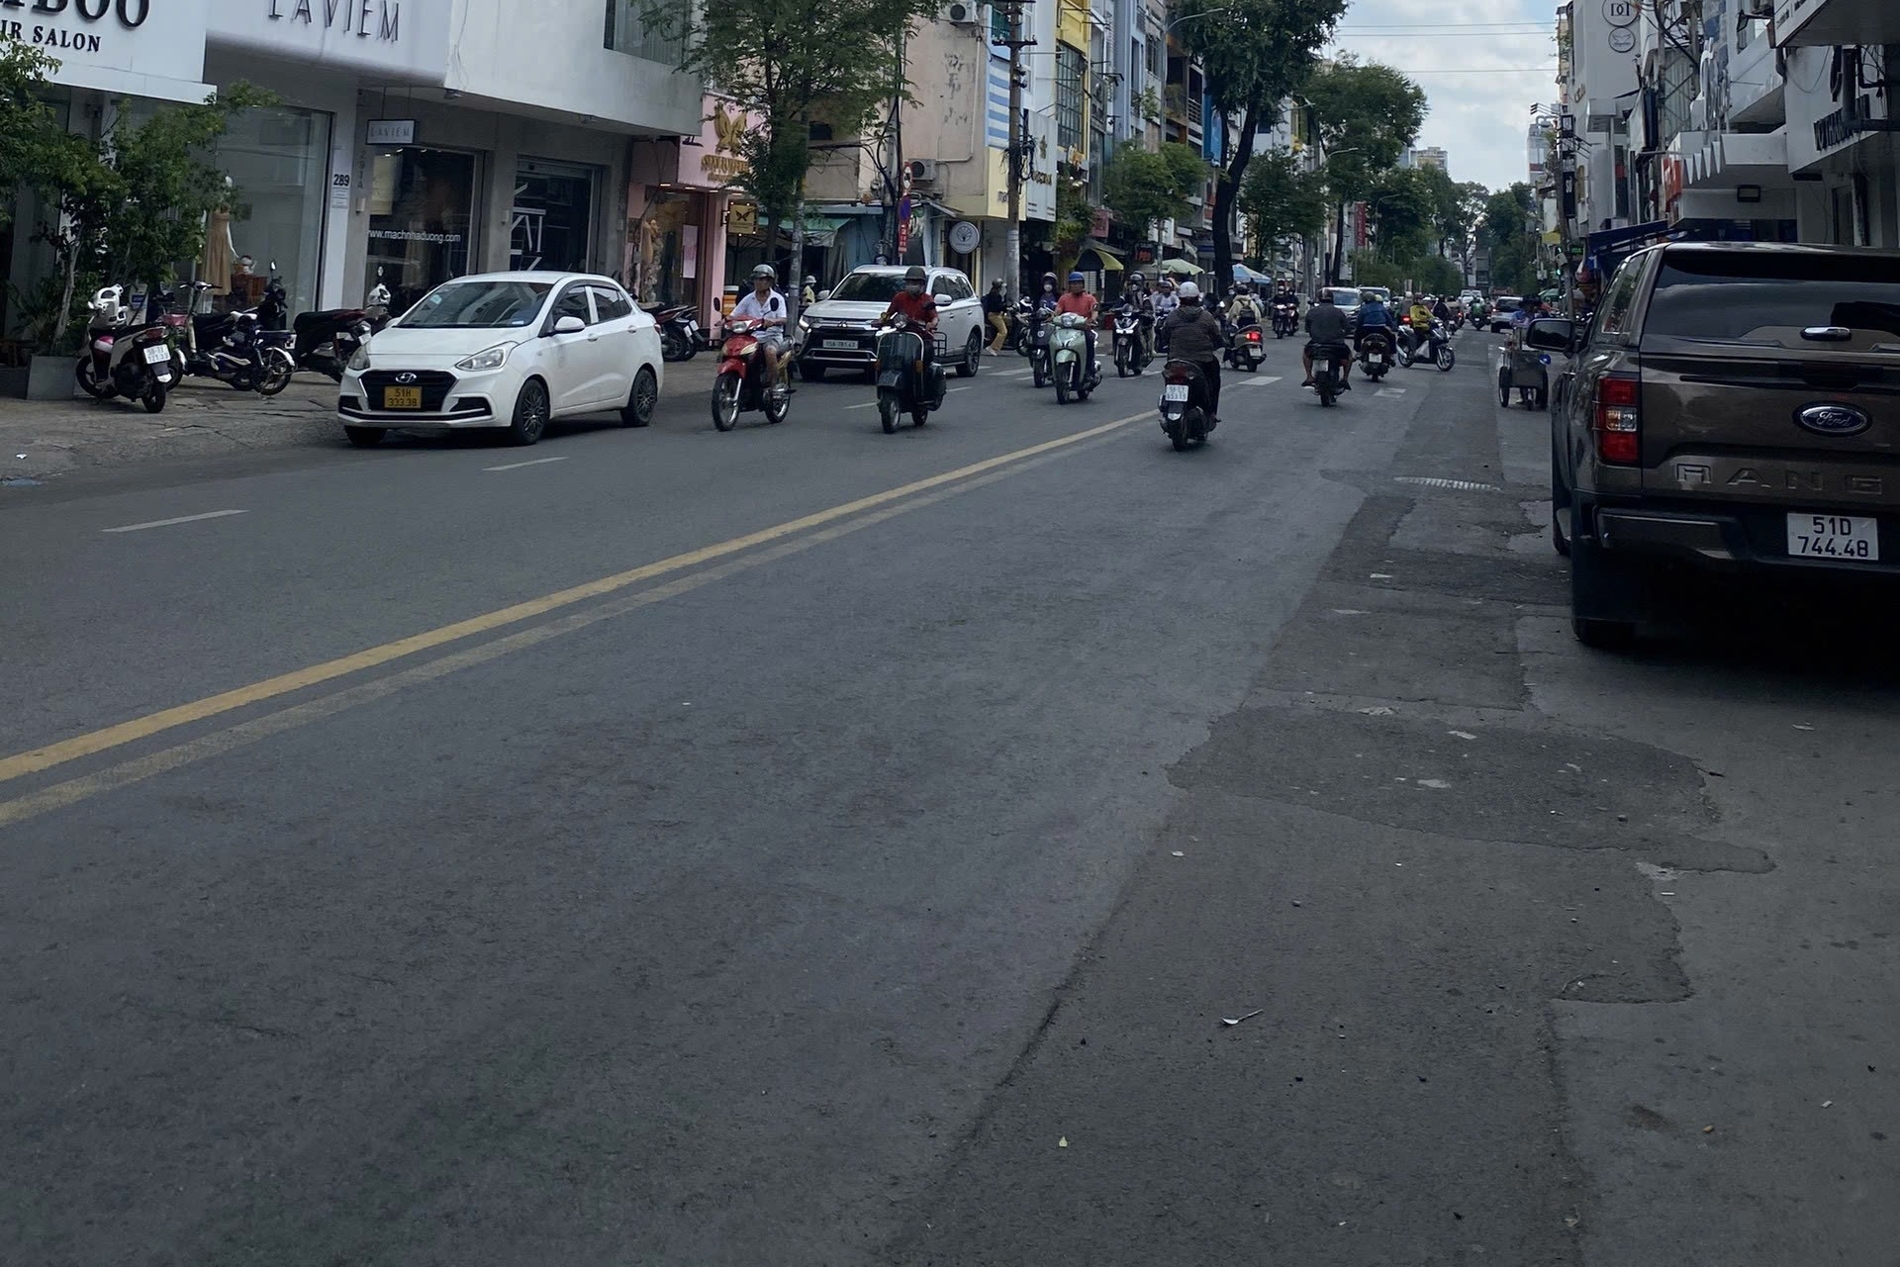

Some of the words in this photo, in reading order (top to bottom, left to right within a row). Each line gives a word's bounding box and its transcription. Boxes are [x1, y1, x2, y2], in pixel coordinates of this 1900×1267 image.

[33, 26, 102, 52] SALON
[370, 127, 411, 137] LAVIEM
[333, 174, 350, 186] 289
[395, 388, 412, 397] 51H
[1815, 411, 1851, 427] Ford
[1812, 516, 1852, 536] 51D
[1797, 536, 1870, 558] 744.48
